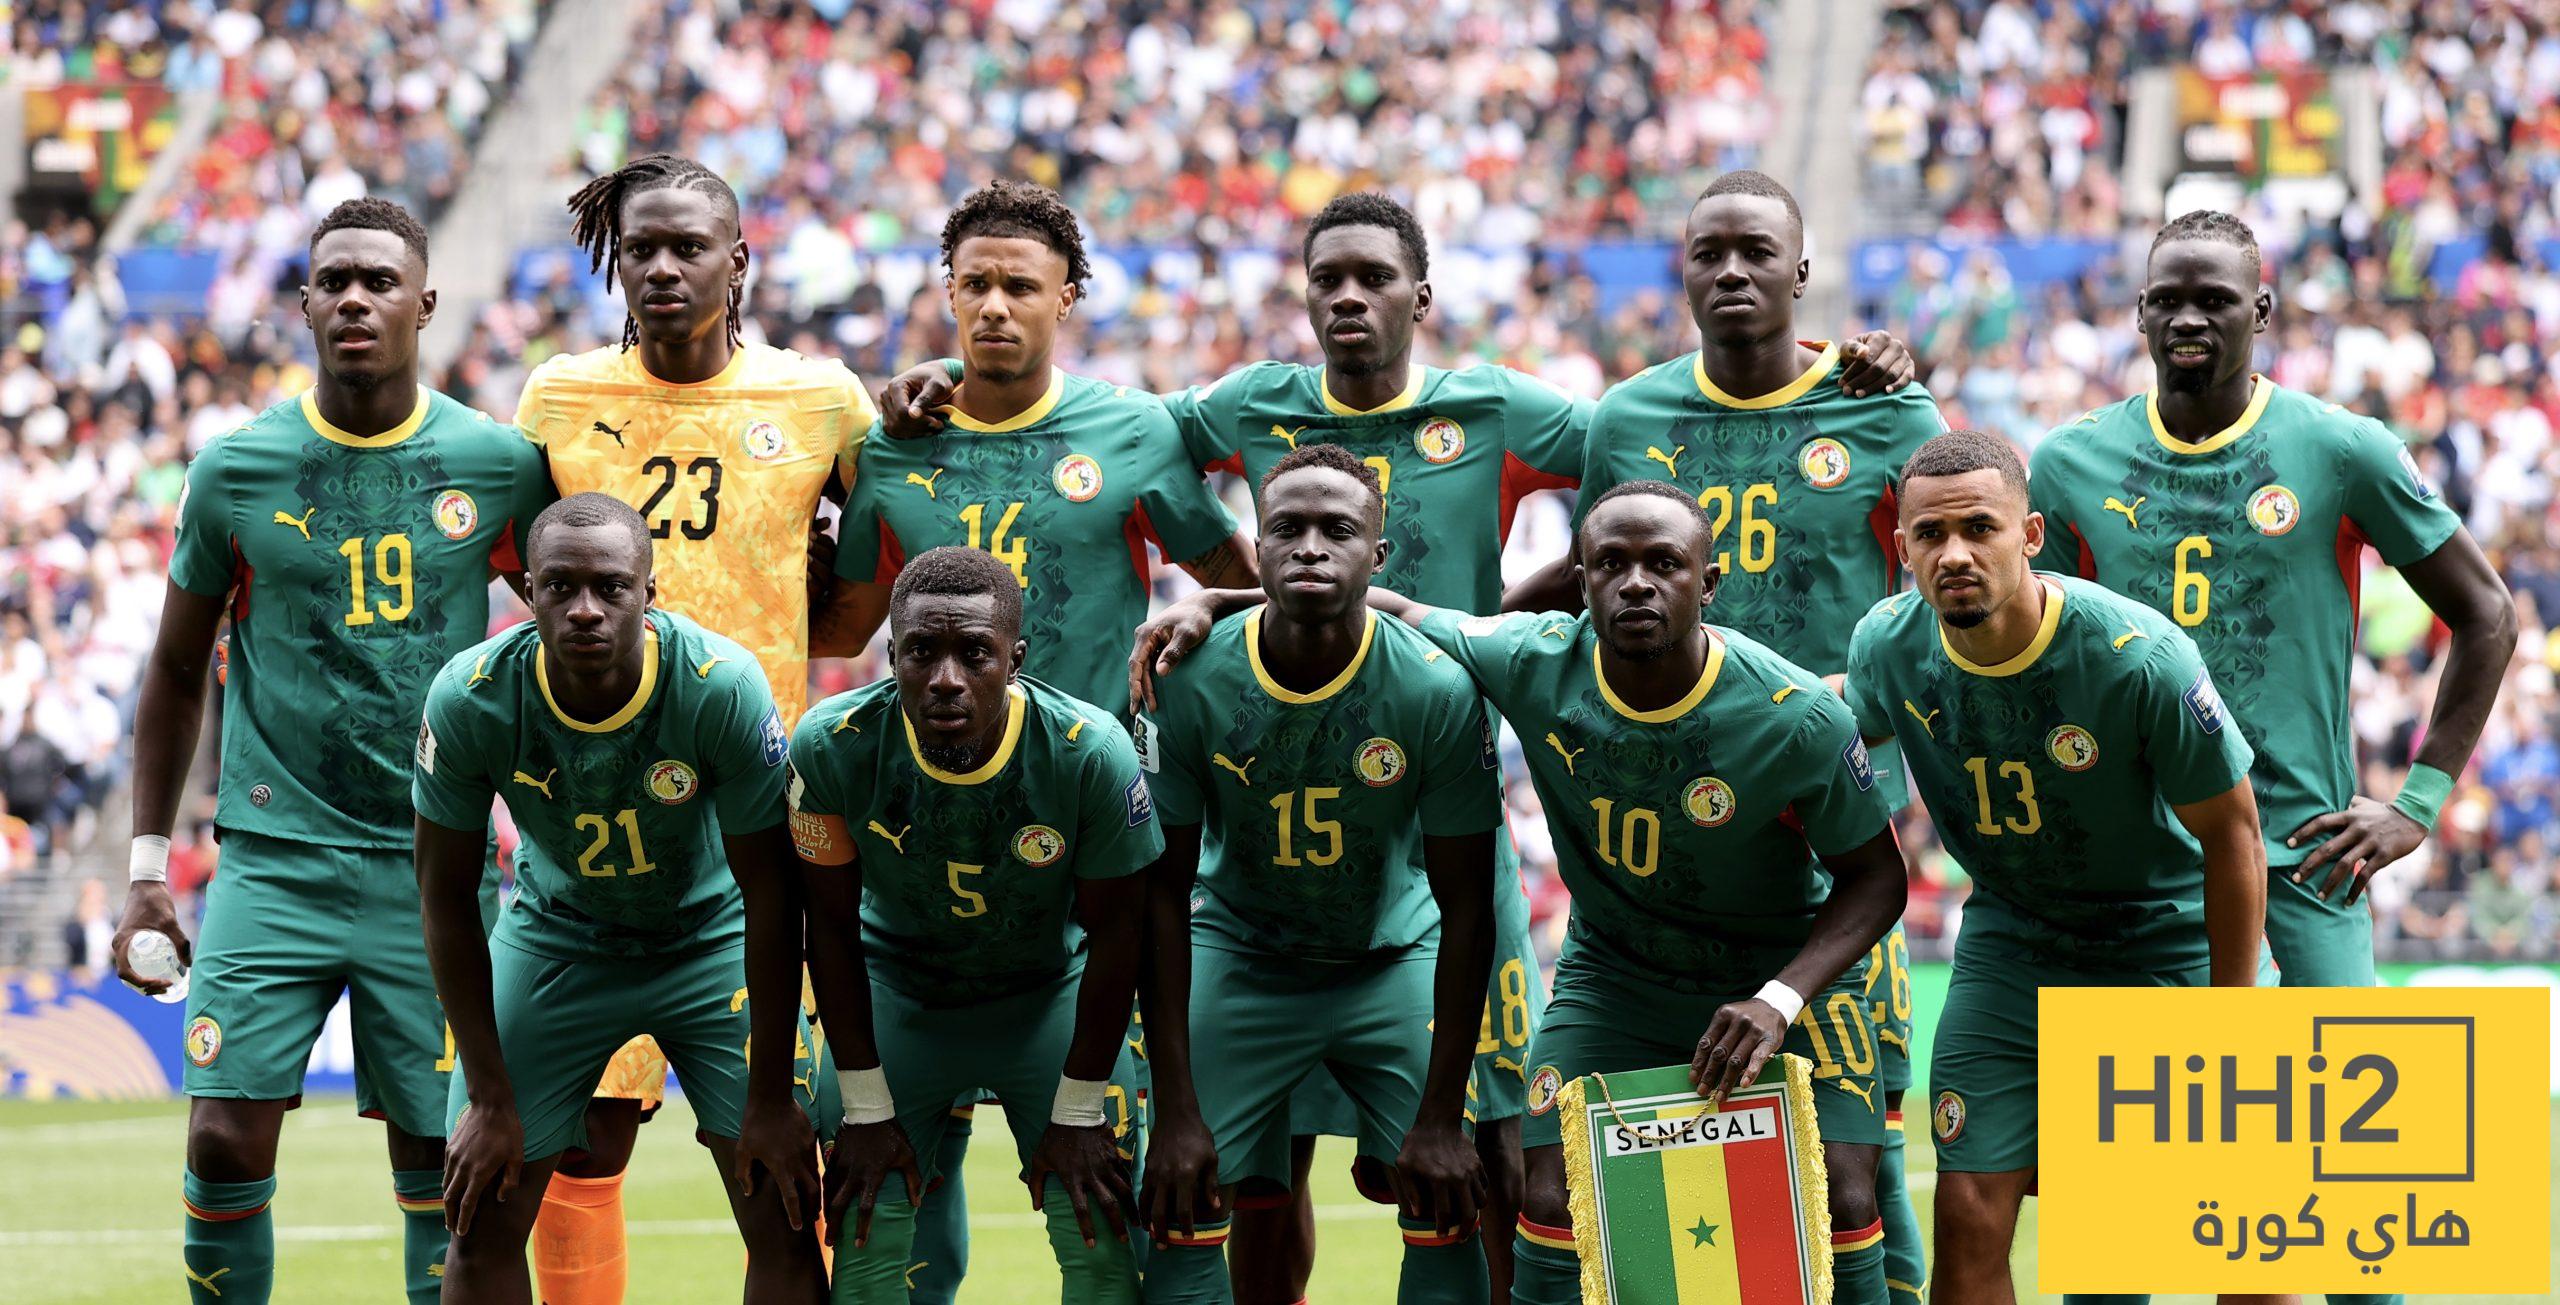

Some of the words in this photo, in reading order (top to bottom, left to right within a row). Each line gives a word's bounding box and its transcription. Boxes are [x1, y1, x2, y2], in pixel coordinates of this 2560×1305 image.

[638, 455, 723, 541] 23
[1697, 483, 1778, 575] 26
[339, 533, 414, 627] 19
[958, 502, 1029, 588] 14
[2172, 535, 2213, 628] 6
[789, 810, 828, 838] UNITES
[1271, 787, 1344, 867] 15
[1590, 797, 1660, 877] 10
[1964, 756, 2042, 836] 13
[575, 809, 656, 878] 21
[799, 832, 832, 852] World
[948, 862, 985, 918] 5
[1475, 958, 1529, 1053] 18
[1864, 932, 1912, 1022] 26
[1794, 993, 1875, 1078] 10
[1616, 1113, 1765, 1151] SENEGAL
